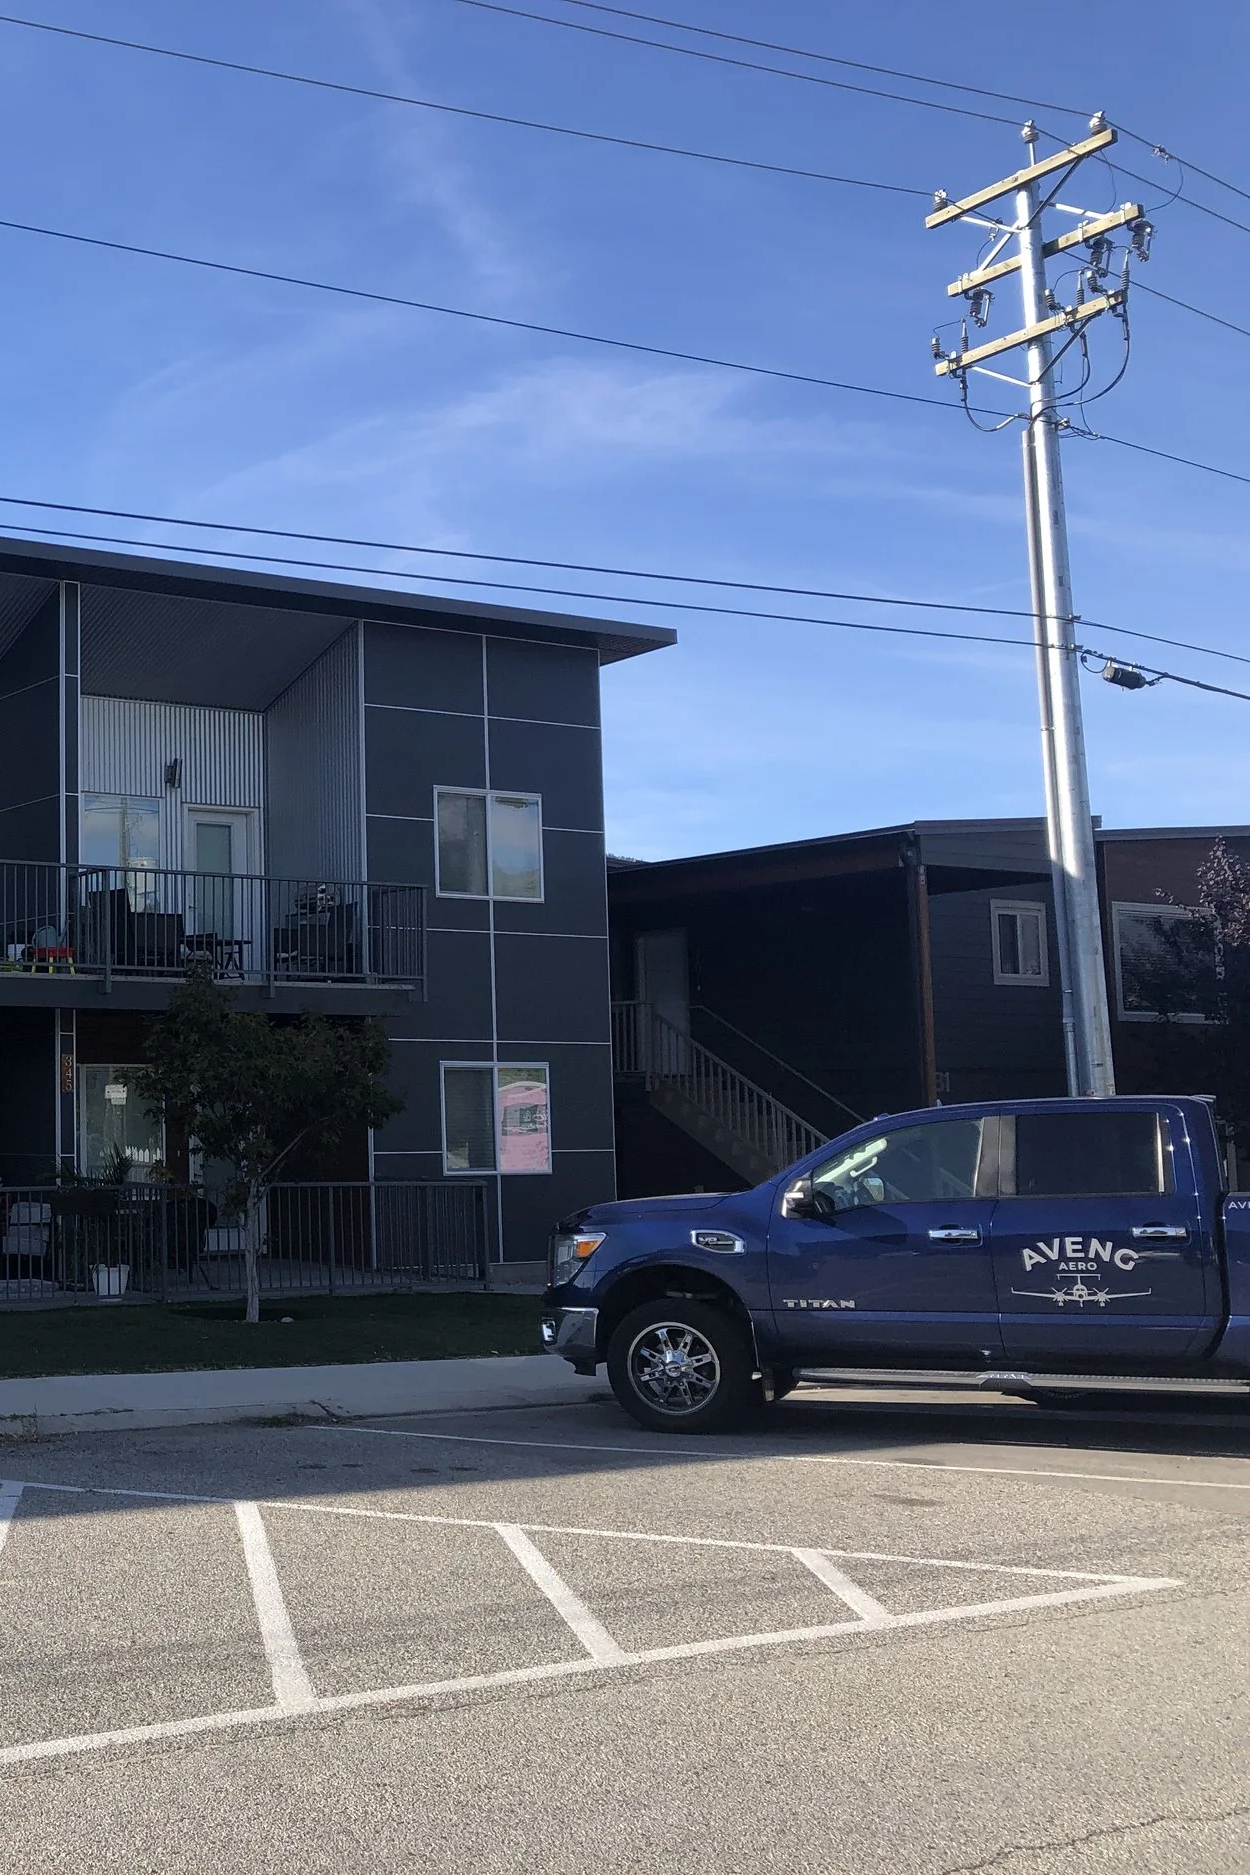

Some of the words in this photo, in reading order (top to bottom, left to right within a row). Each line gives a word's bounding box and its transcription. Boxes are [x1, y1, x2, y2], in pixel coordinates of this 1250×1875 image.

[65, 1056, 73, 1091] 345
[1022, 1236, 1139, 1272] AVENG
[1058, 1262, 1098, 1271] AERO
[783, 1299, 856, 1309] TITAN
